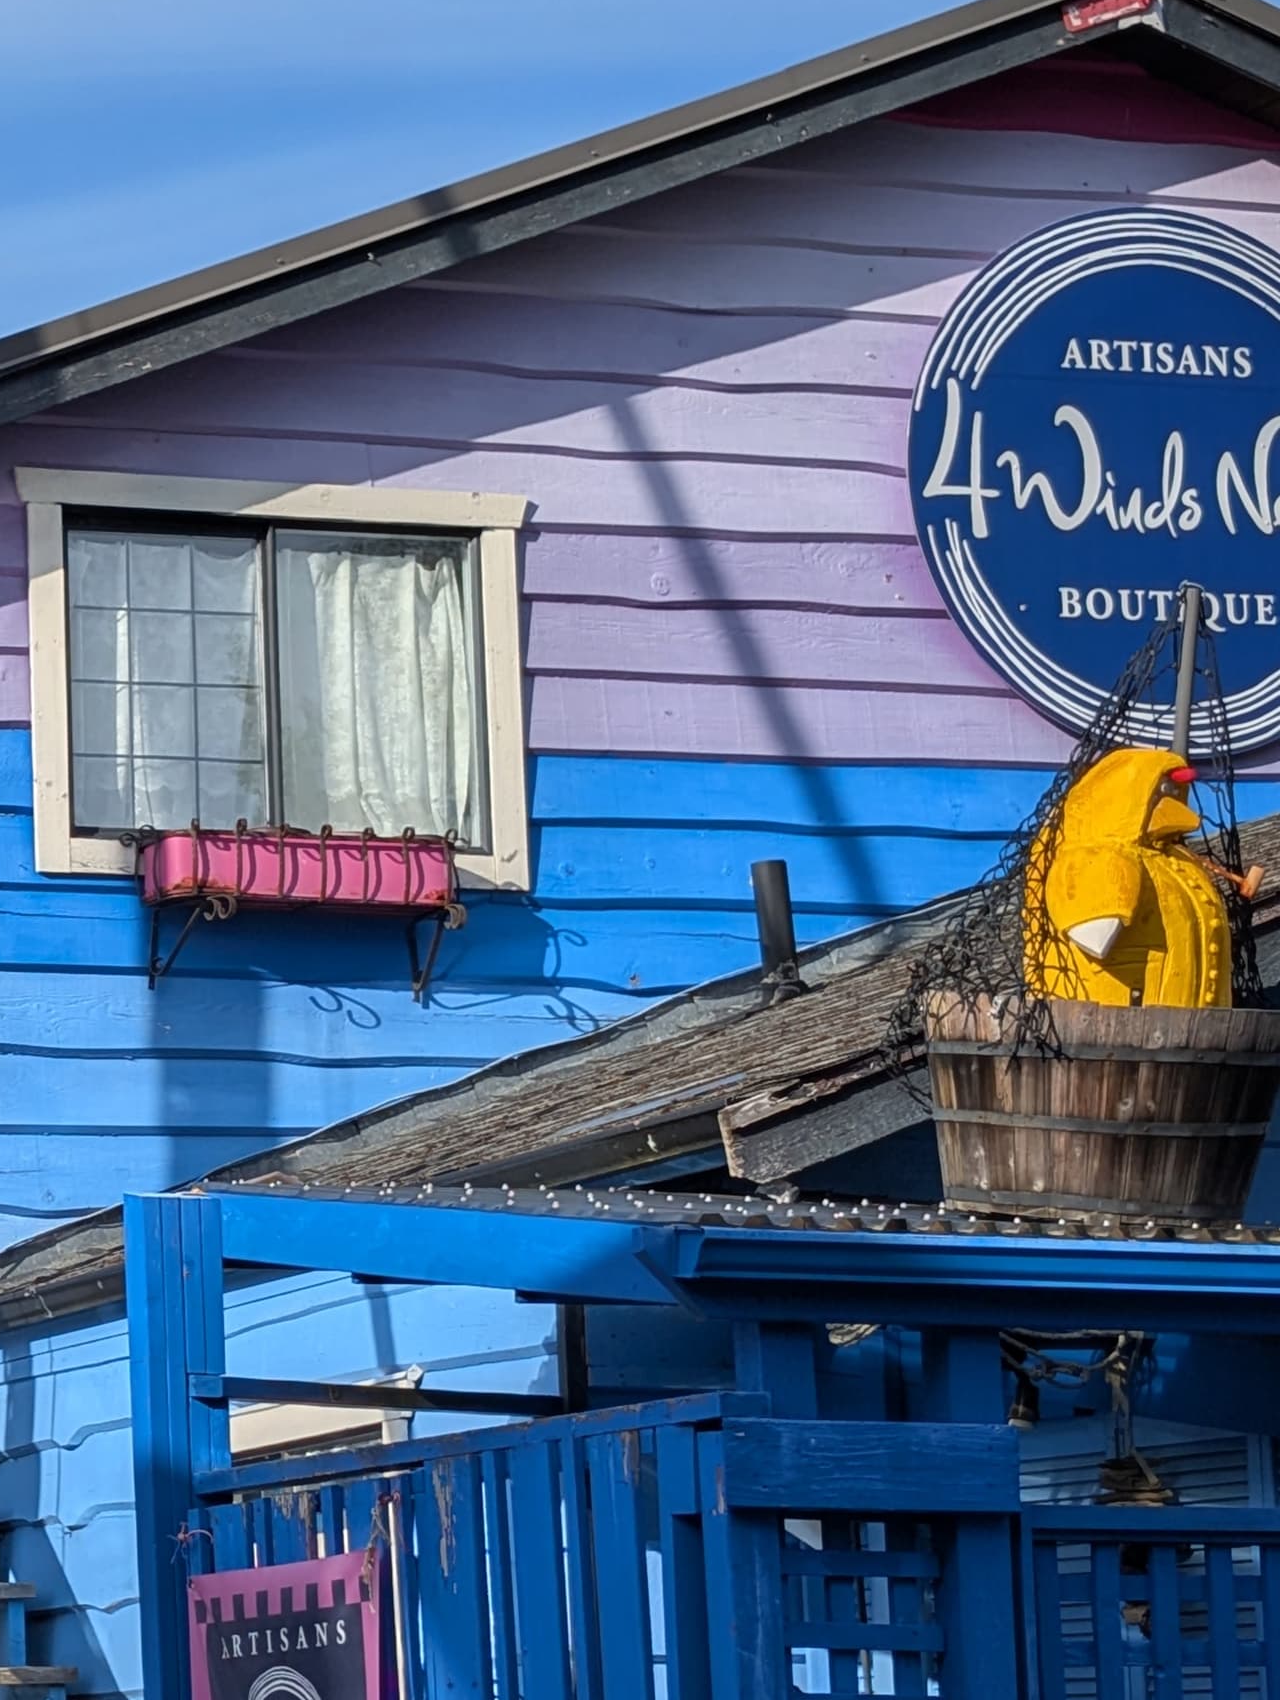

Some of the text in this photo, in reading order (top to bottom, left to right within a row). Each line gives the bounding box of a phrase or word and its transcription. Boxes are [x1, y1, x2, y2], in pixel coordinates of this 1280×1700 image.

[1060, 338, 1253, 378] ARTISANS
[1216, 414, 1280, 535] N
[221, 1619, 347, 1660] ARTISANS
